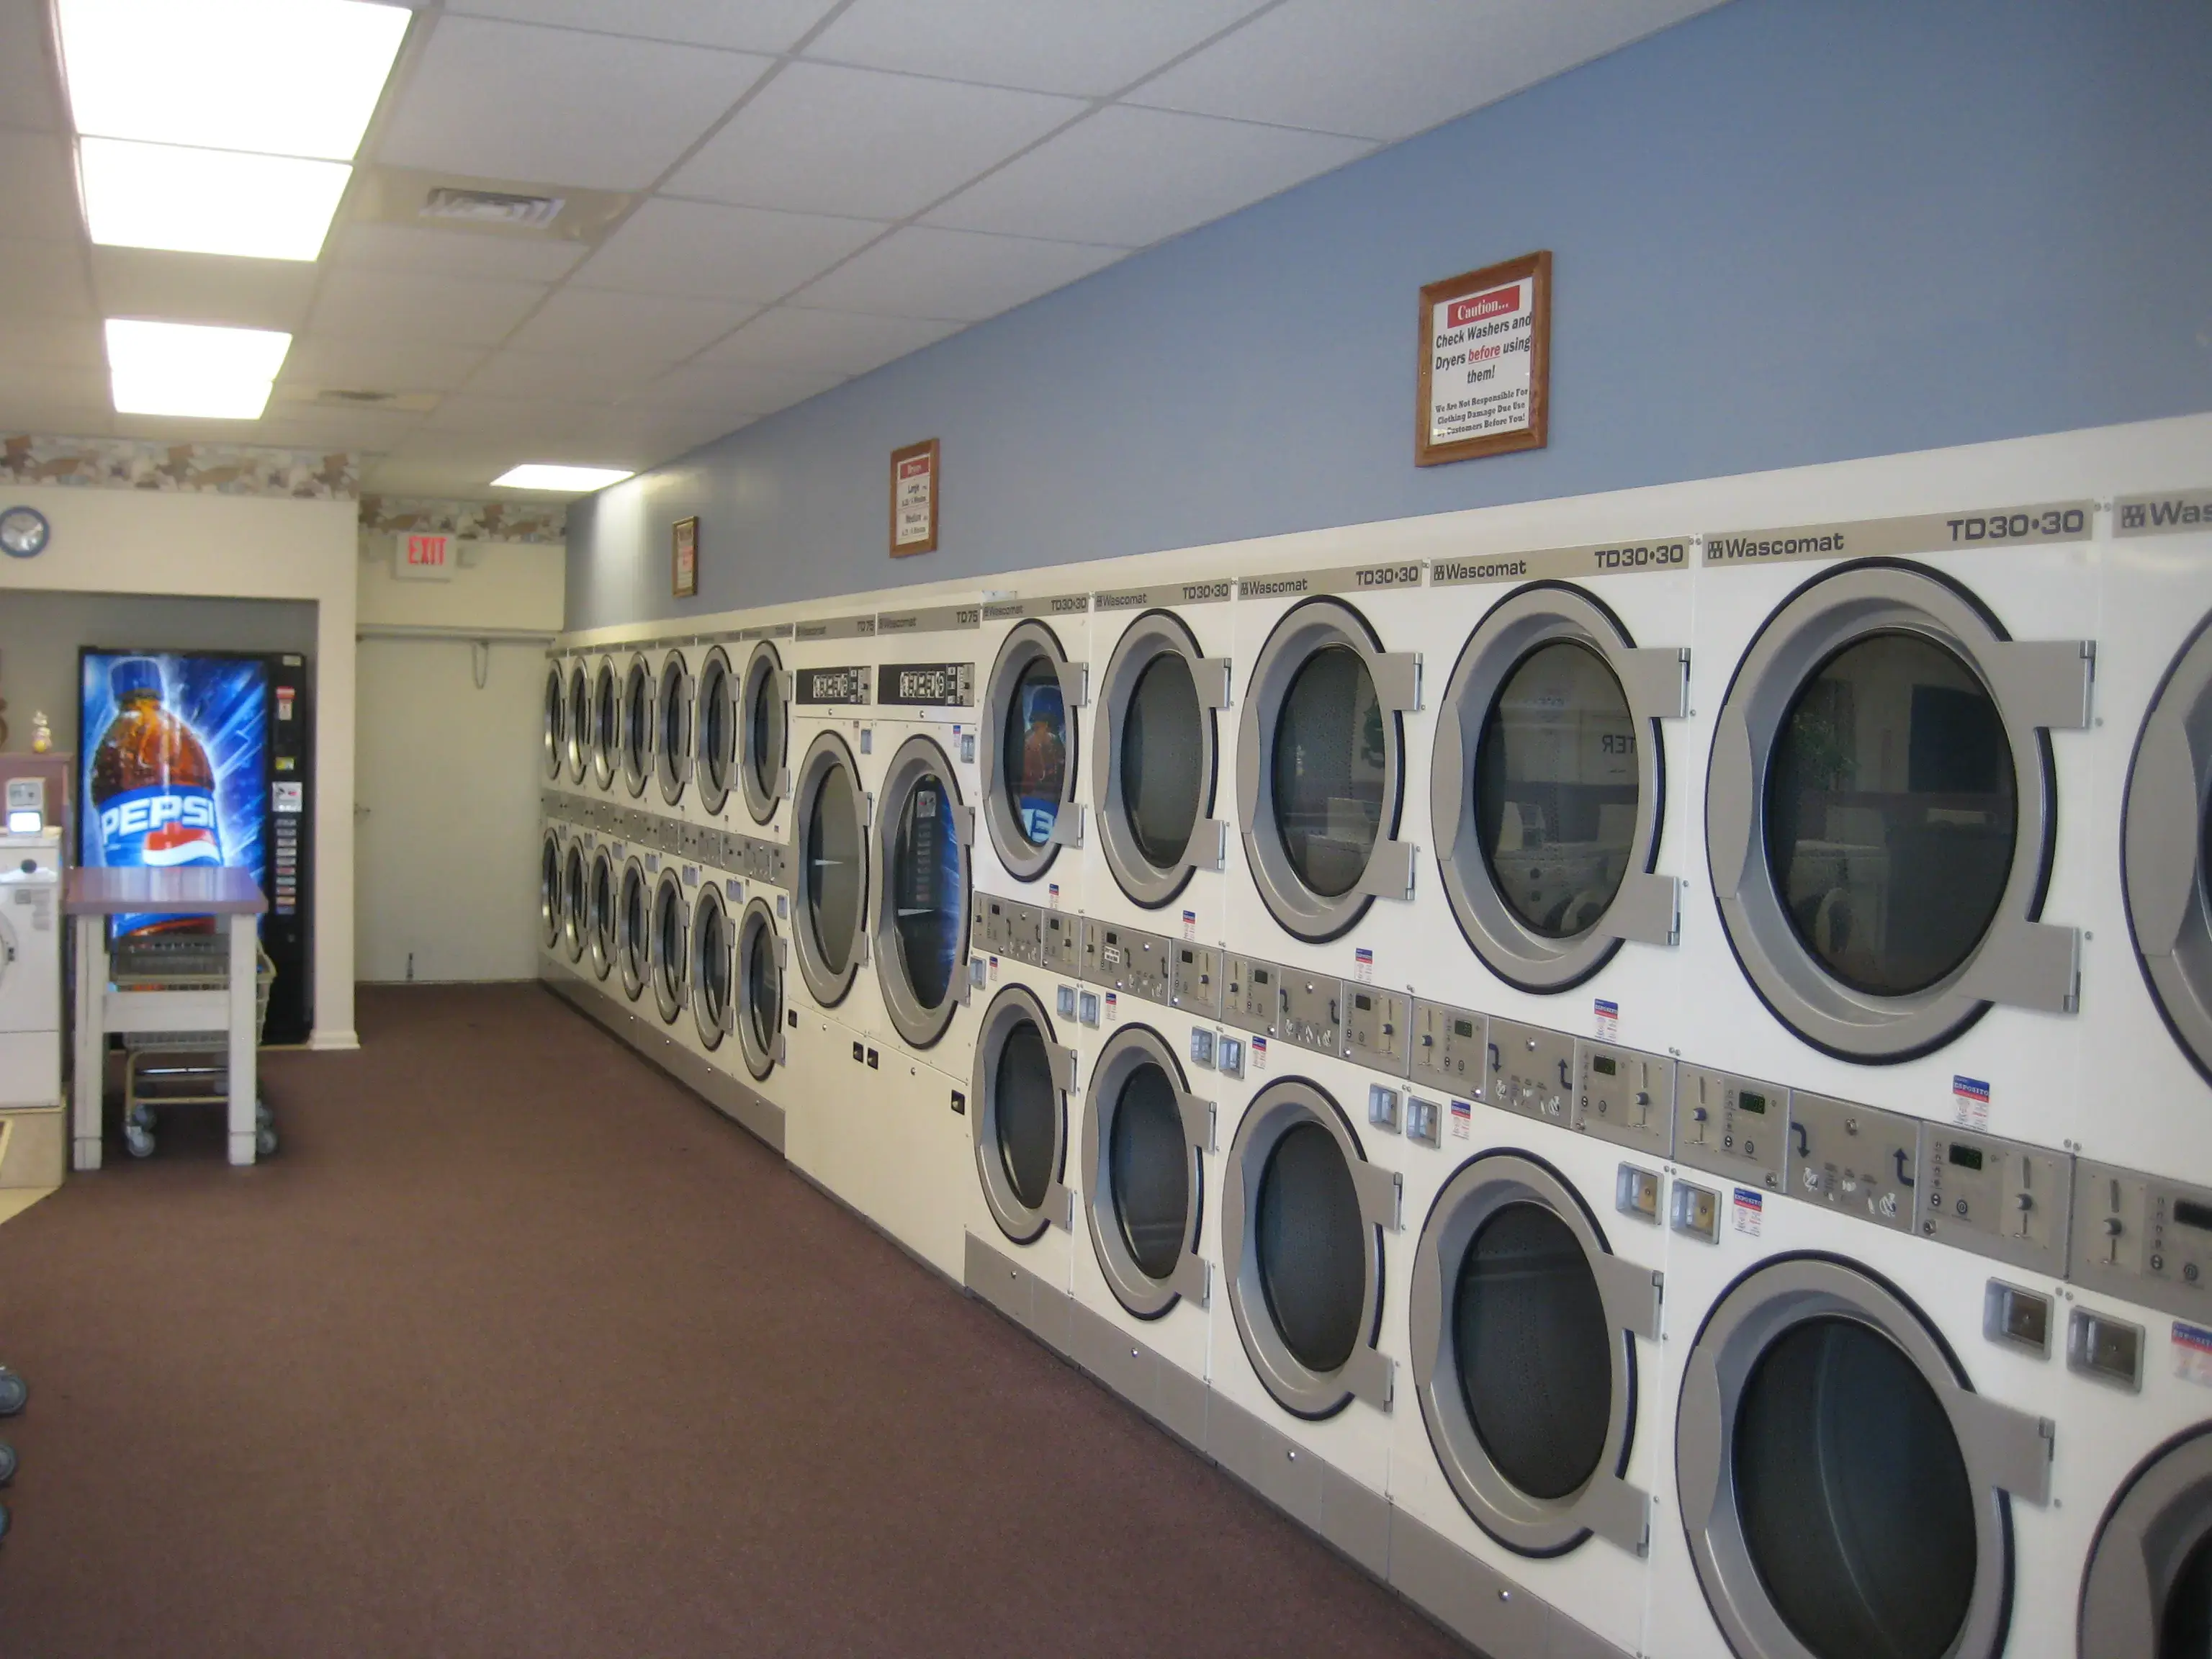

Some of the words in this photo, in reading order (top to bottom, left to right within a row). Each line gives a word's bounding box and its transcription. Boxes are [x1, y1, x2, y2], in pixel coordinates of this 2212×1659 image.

[1457, 299, 1509, 320] Caution...
[1436, 330, 1465, 349] Check
[1467, 321, 1510, 341] Washers
[1511, 312, 1532, 330] and
[1435, 353, 1466, 371] Dryers
[1468, 345, 1501, 364] before
[1503, 336, 1531, 354] using
[1467, 364, 1496, 384] them!
[1435, 404, 1445, 413] We
[1446, 402, 1458, 412] Are
[1458, 399, 1470, 408] Not
[1472, 390, 1514, 405] Responsible
[1515, 388, 1528, 397] For
[1437, 413, 1466, 425] Clothing
[1467, 408, 1496, 420] Damage
[1497, 404, 1511, 413] Due
[1513, 401, 1526, 410] Use
[1484, 416, 1508, 428] Before
[1509, 412, 1526, 425] You!
[408, 535, 448, 565] EXIT
[1725, 533, 1844, 559] Wascomat
[1445, 559, 1527, 579] Wascomat
[1250, 578, 1308, 595] Wascomat
[1102, 593, 1147, 607] Wascomat
[956, 610, 979, 624] TD75
[102, 794, 215, 845] PEPSI
[1954, 1082, 1989, 1096] ESPOSITO
